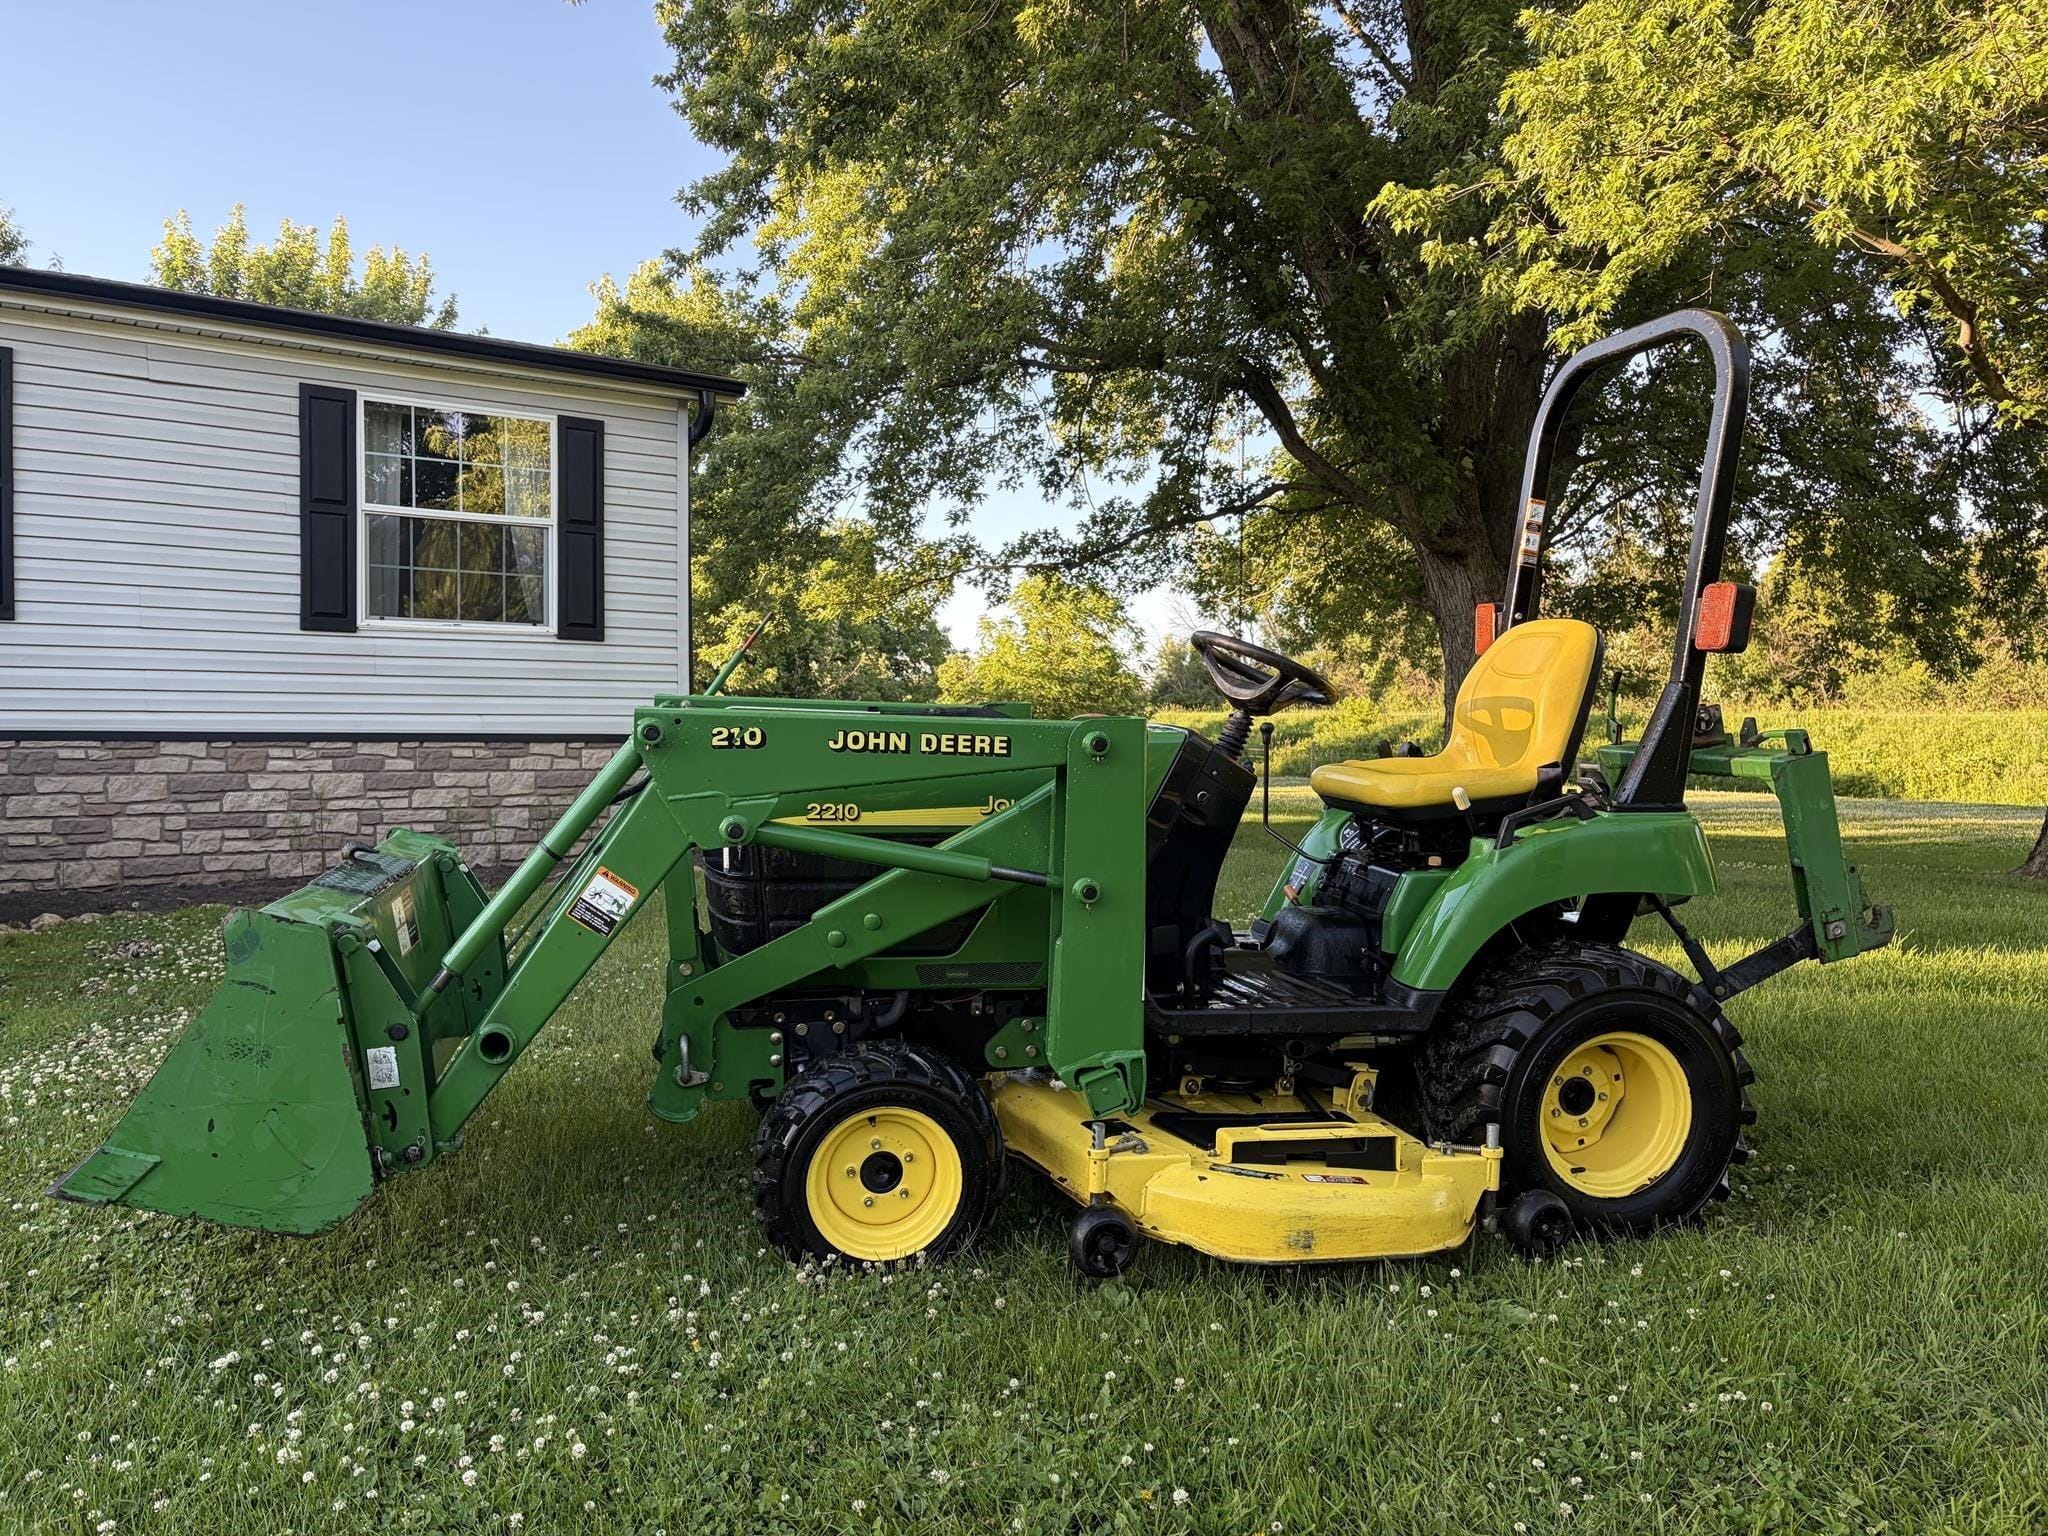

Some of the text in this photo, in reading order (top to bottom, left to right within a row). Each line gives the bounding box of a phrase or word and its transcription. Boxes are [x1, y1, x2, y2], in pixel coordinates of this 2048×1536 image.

[711, 726, 766, 749] 210
[828, 730, 1011, 757] JOHN DEERE
[806, 803, 860, 821] 2210
[610, 874, 637, 895] WARNING
